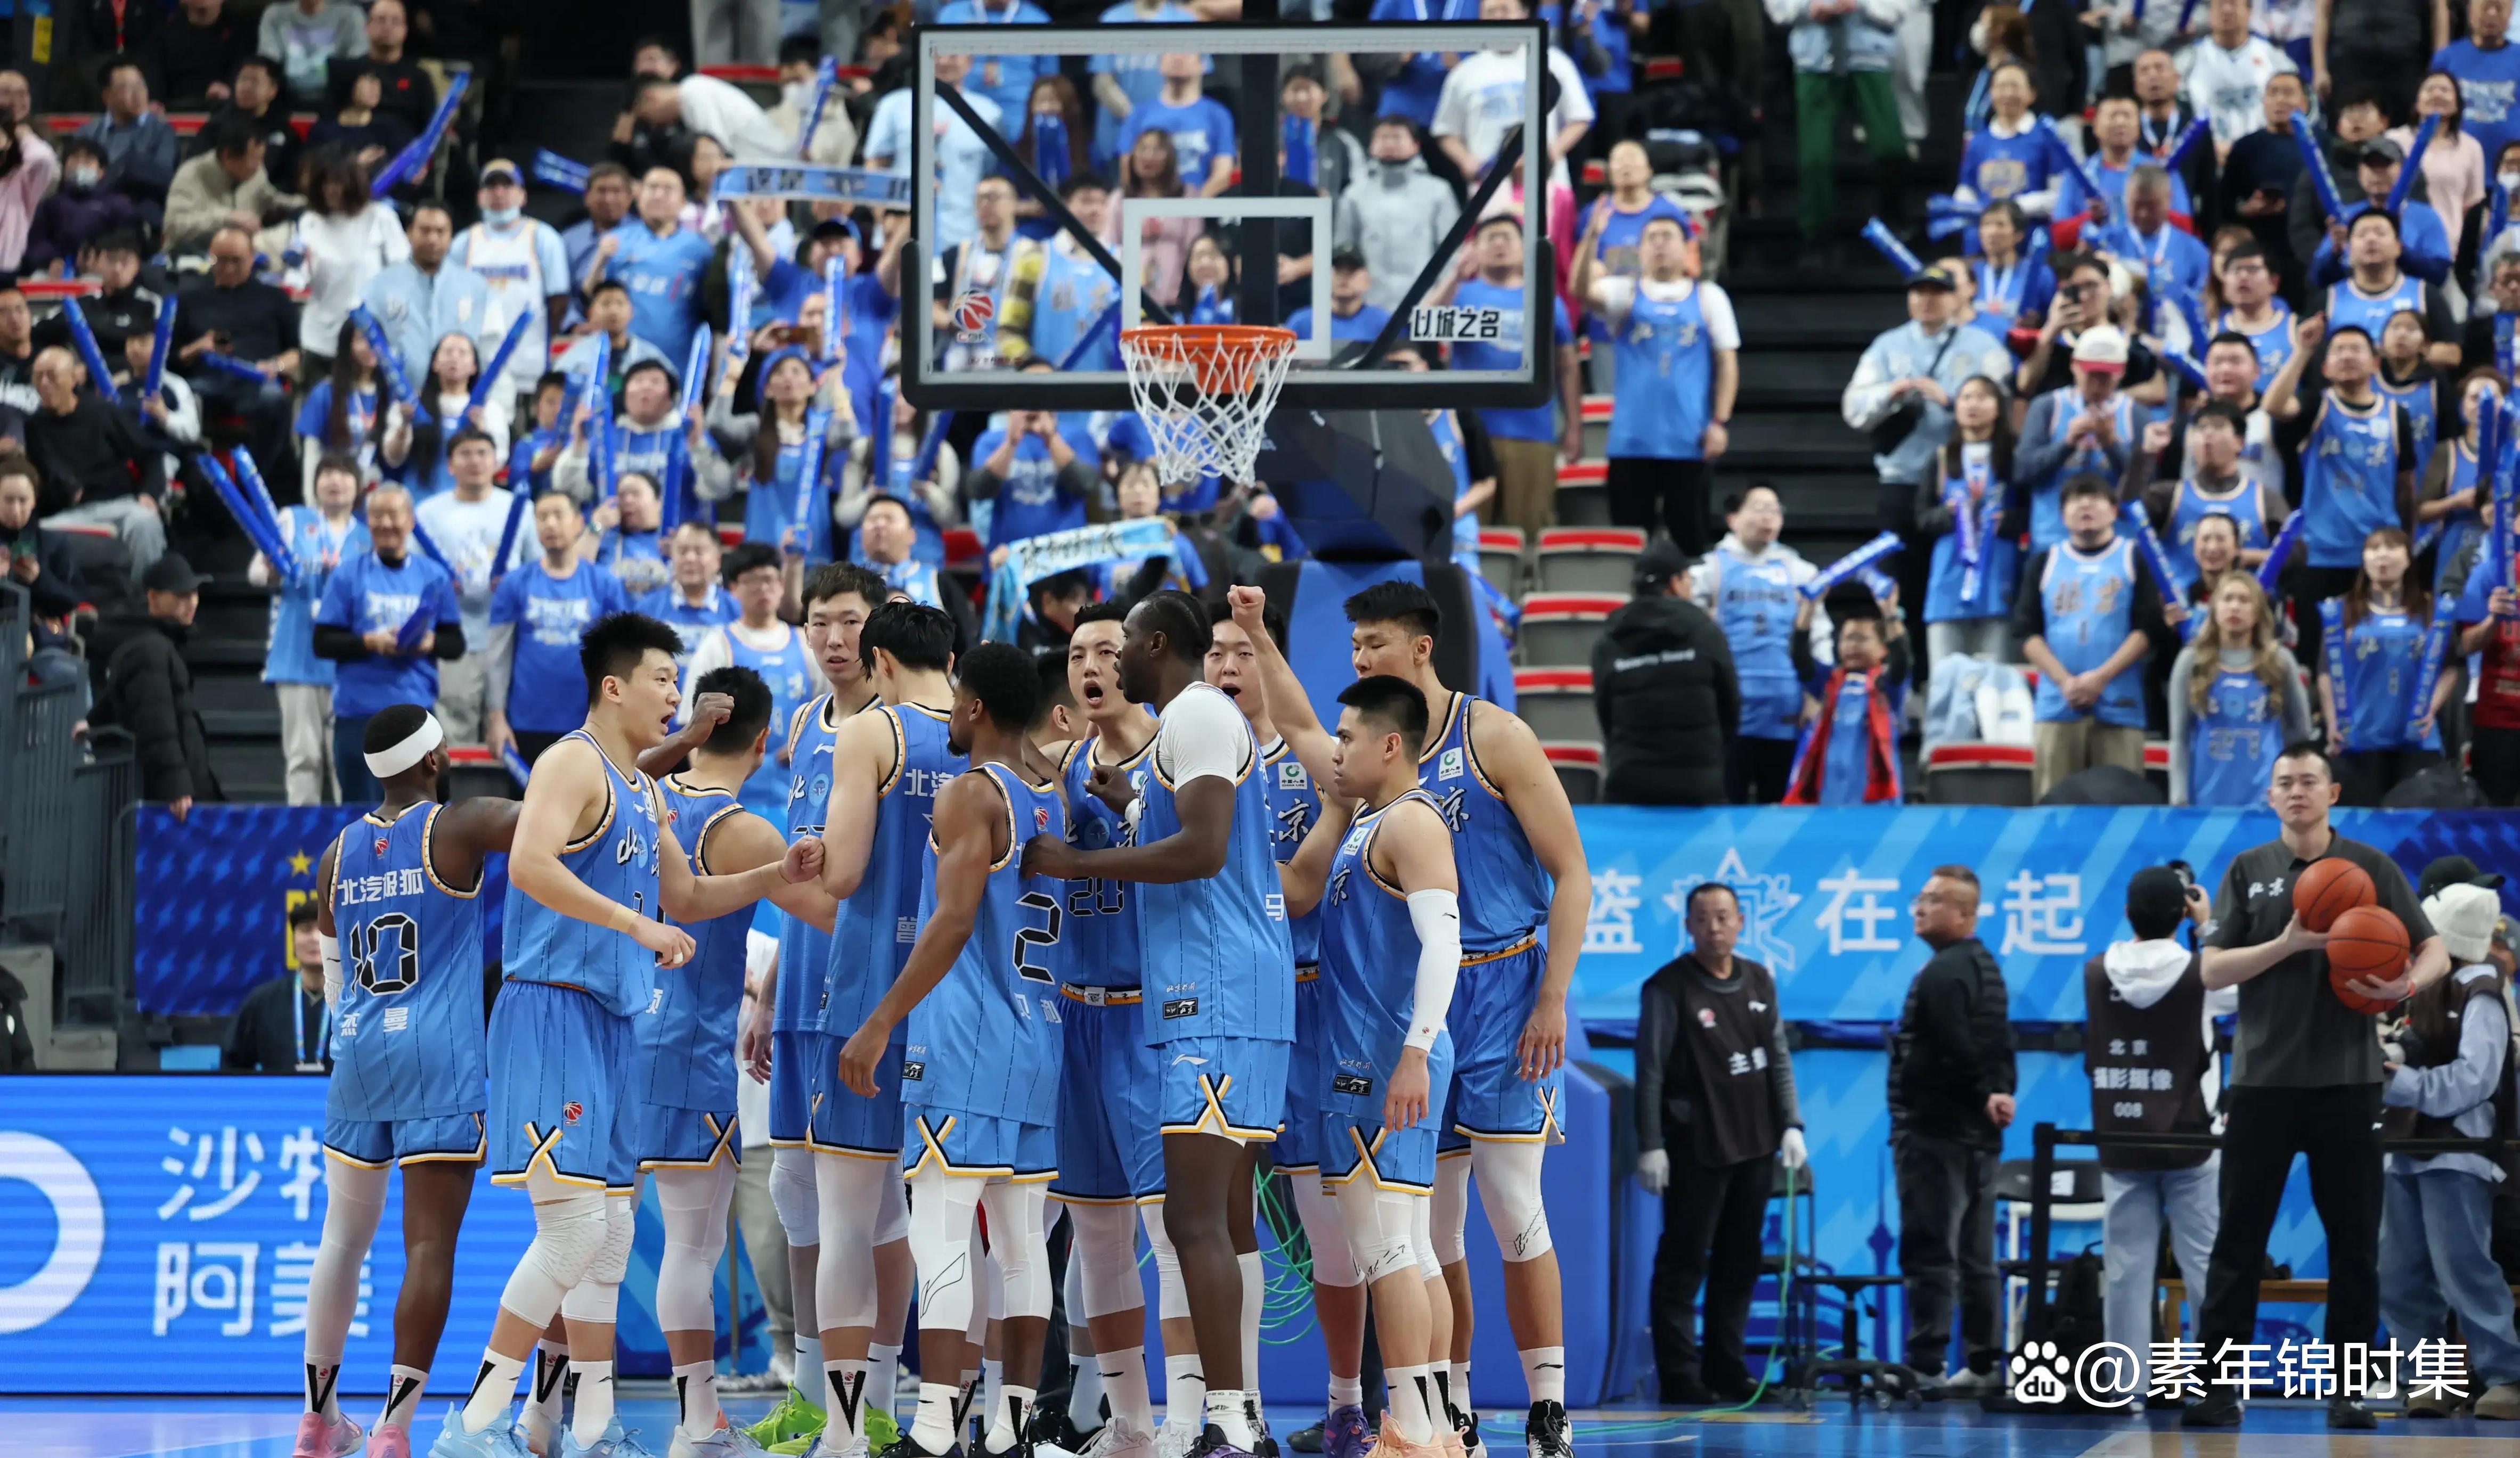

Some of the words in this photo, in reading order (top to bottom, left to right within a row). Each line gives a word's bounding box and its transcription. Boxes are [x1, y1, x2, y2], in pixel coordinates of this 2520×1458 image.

[1414, 308, 1500, 338] 以城之名
[1277, 798, 1310, 842] 京
[349, 912, 419, 996] 10
[1013, 890, 1063, 985] 2
